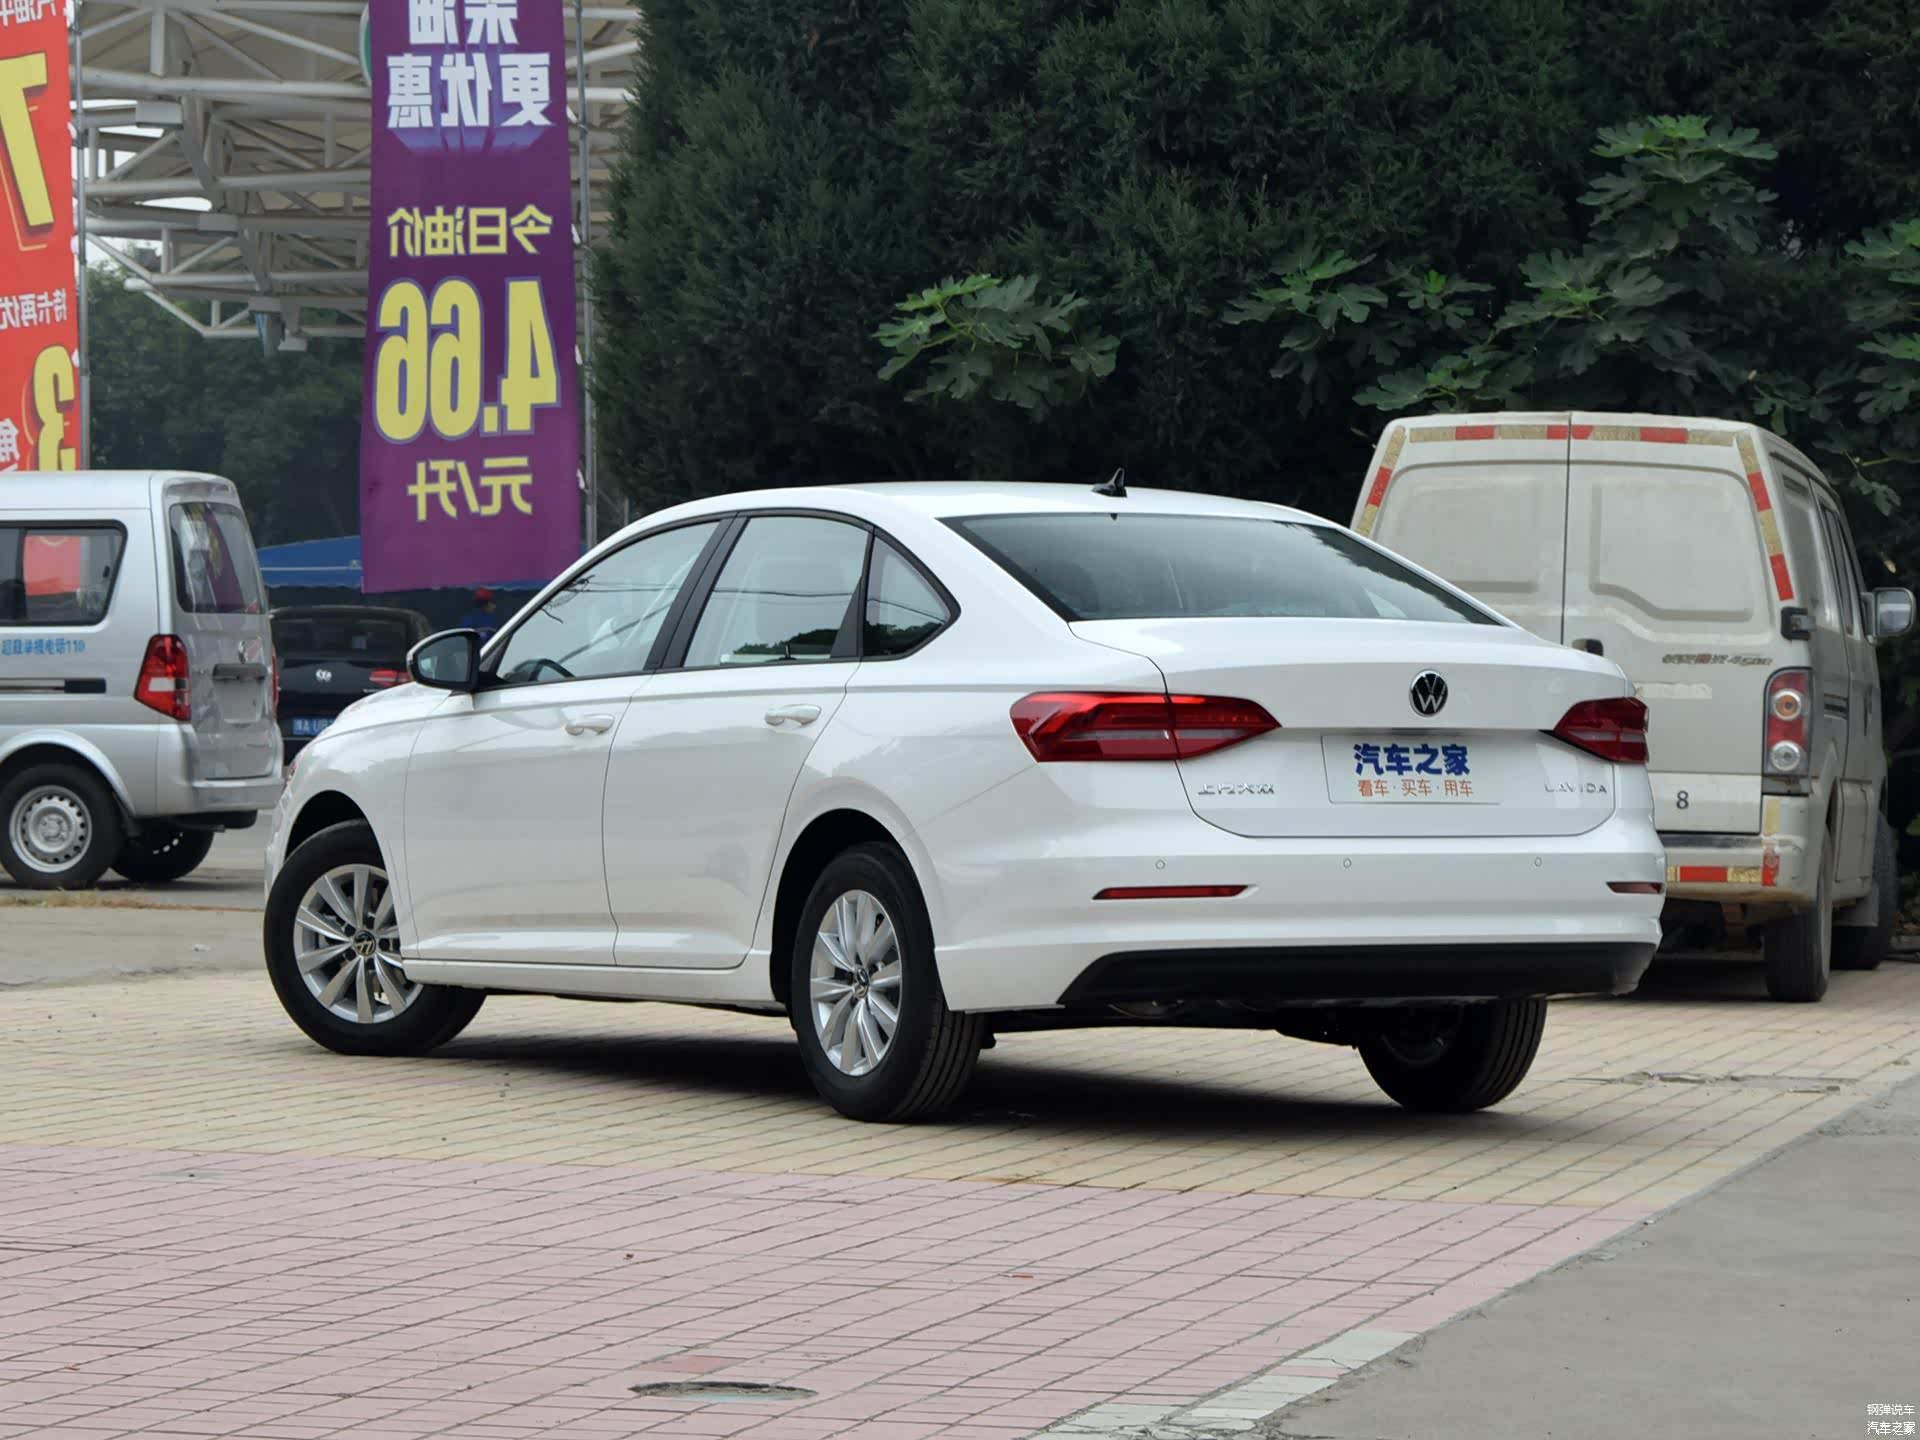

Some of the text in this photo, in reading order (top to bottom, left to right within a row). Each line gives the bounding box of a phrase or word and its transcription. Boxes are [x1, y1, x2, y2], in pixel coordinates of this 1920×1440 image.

[1353, 743, 1470, 776] 汽车之家
[1676, 790, 1689, 810] 8
